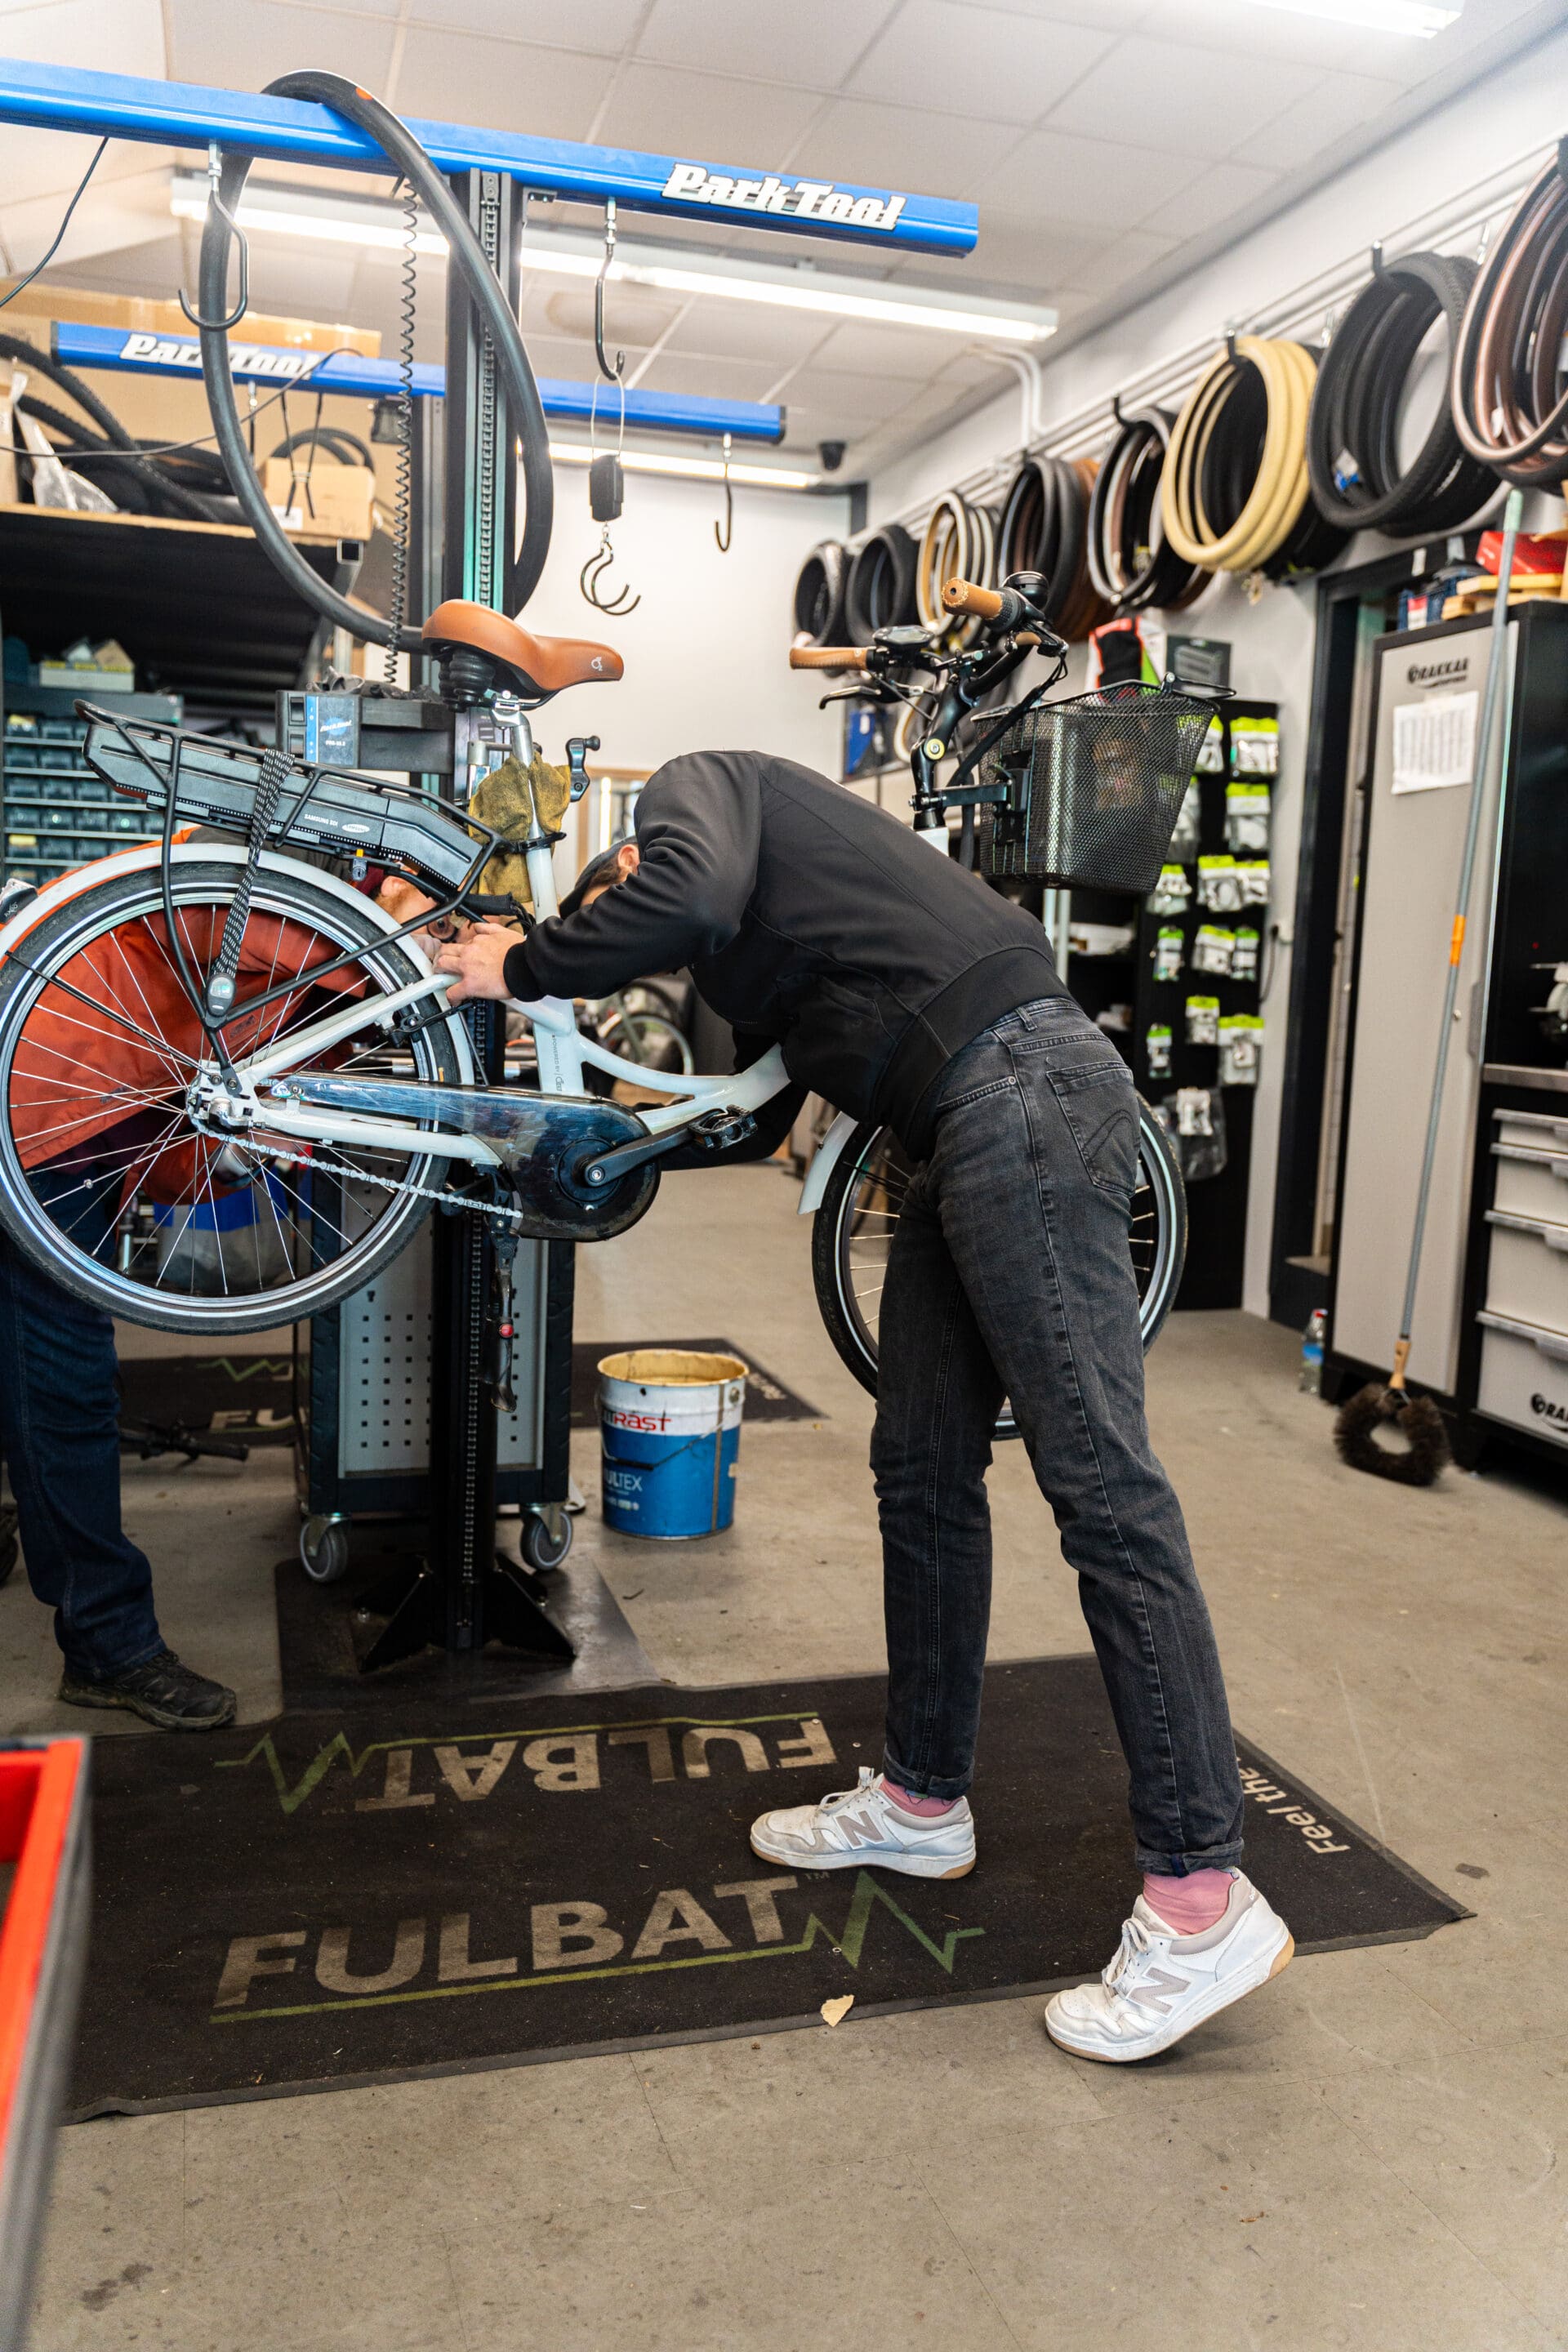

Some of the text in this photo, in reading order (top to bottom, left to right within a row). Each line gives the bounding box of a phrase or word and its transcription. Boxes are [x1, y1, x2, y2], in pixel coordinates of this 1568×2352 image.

[304, 813, 329, 825] SAMSUNG
[354, 1718, 838, 1812] FULBAT
[1266, 1805, 1351, 1854] Feel
[212, 1876, 799, 2009] FULBAT
